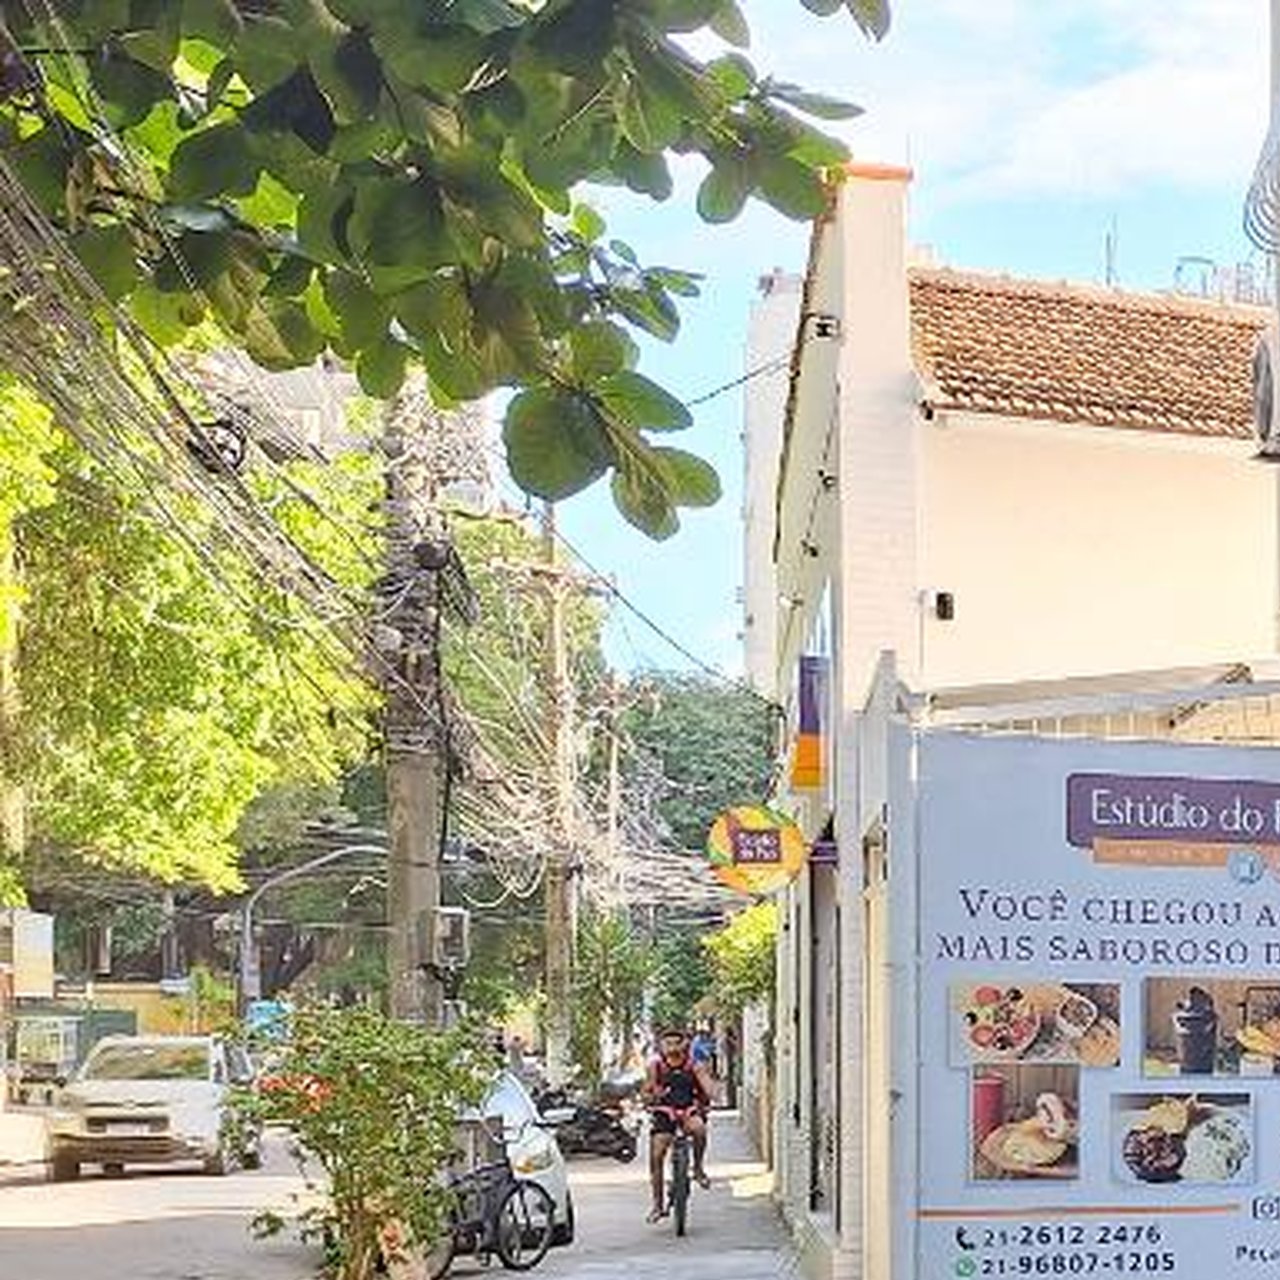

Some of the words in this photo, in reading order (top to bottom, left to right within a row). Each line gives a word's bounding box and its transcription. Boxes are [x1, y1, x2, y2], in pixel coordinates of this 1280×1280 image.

[1092, 788, 1208, 829] Estúdio
[1219, 793, 1264, 832] do
[958, 889, 1069, 922] VOCÊ
[1082, 898, 1242, 926] CHEGOU
[937, 934, 1035, 962] MAIS
[1049, 936, 1248, 965] SABOROSO
[981, 1252, 1177, 1275] 21-96807-1205
